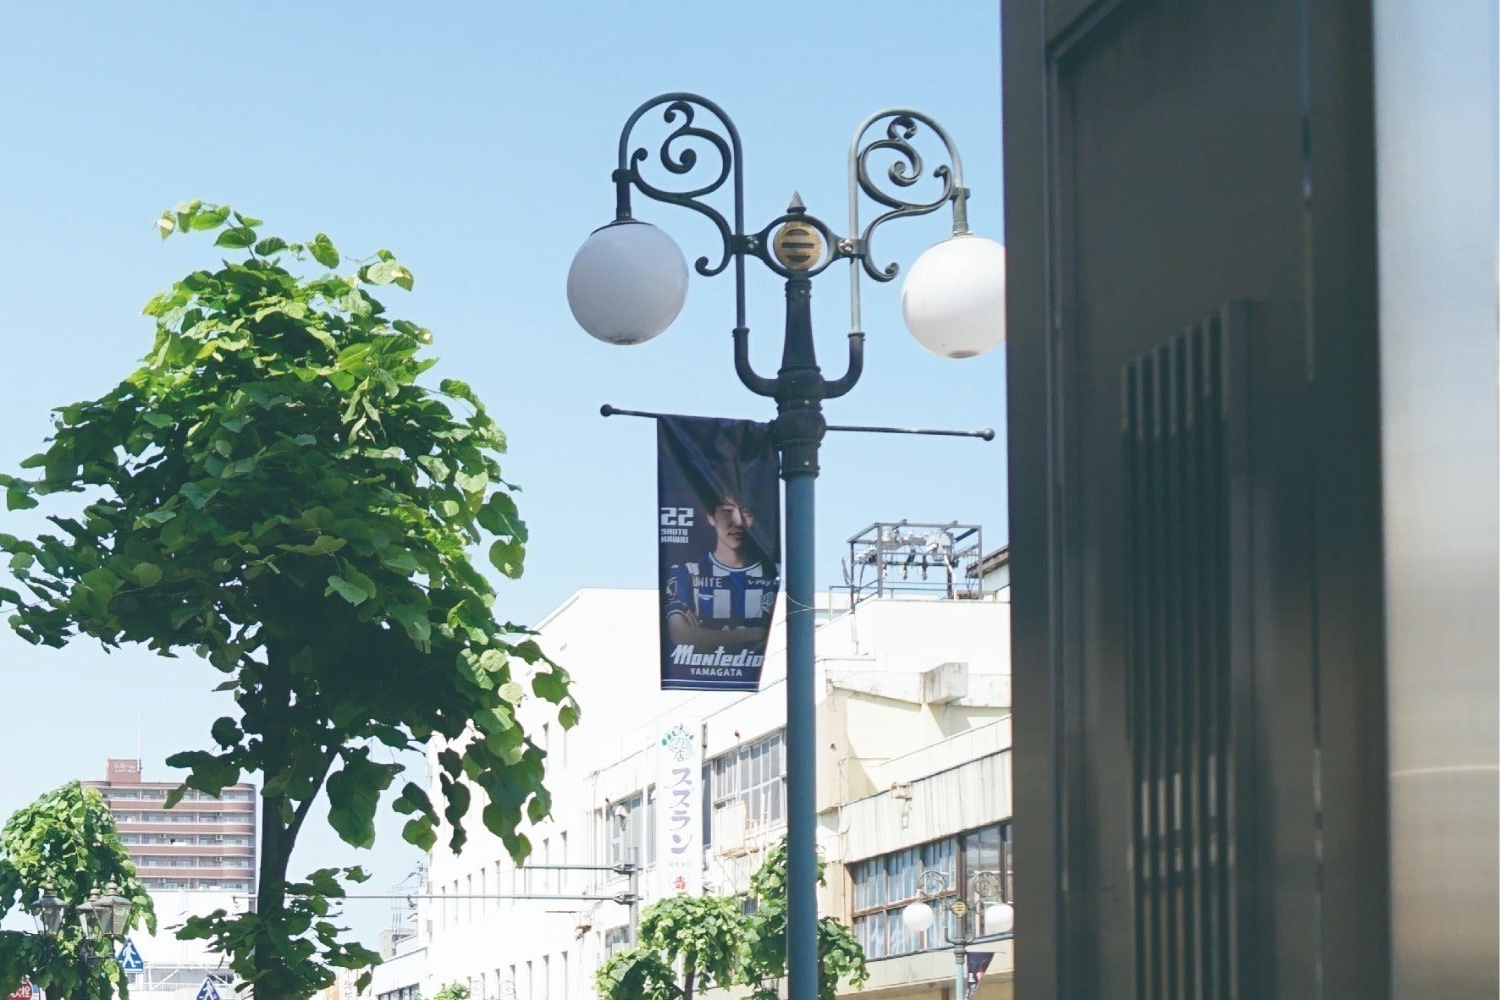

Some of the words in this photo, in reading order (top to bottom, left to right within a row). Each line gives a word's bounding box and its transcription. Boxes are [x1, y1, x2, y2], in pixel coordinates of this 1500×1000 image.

[660, 507, 694, 526] 22
[670, 644, 764, 667] Montedio
[690, 667, 743, 677] YAMAGATA
